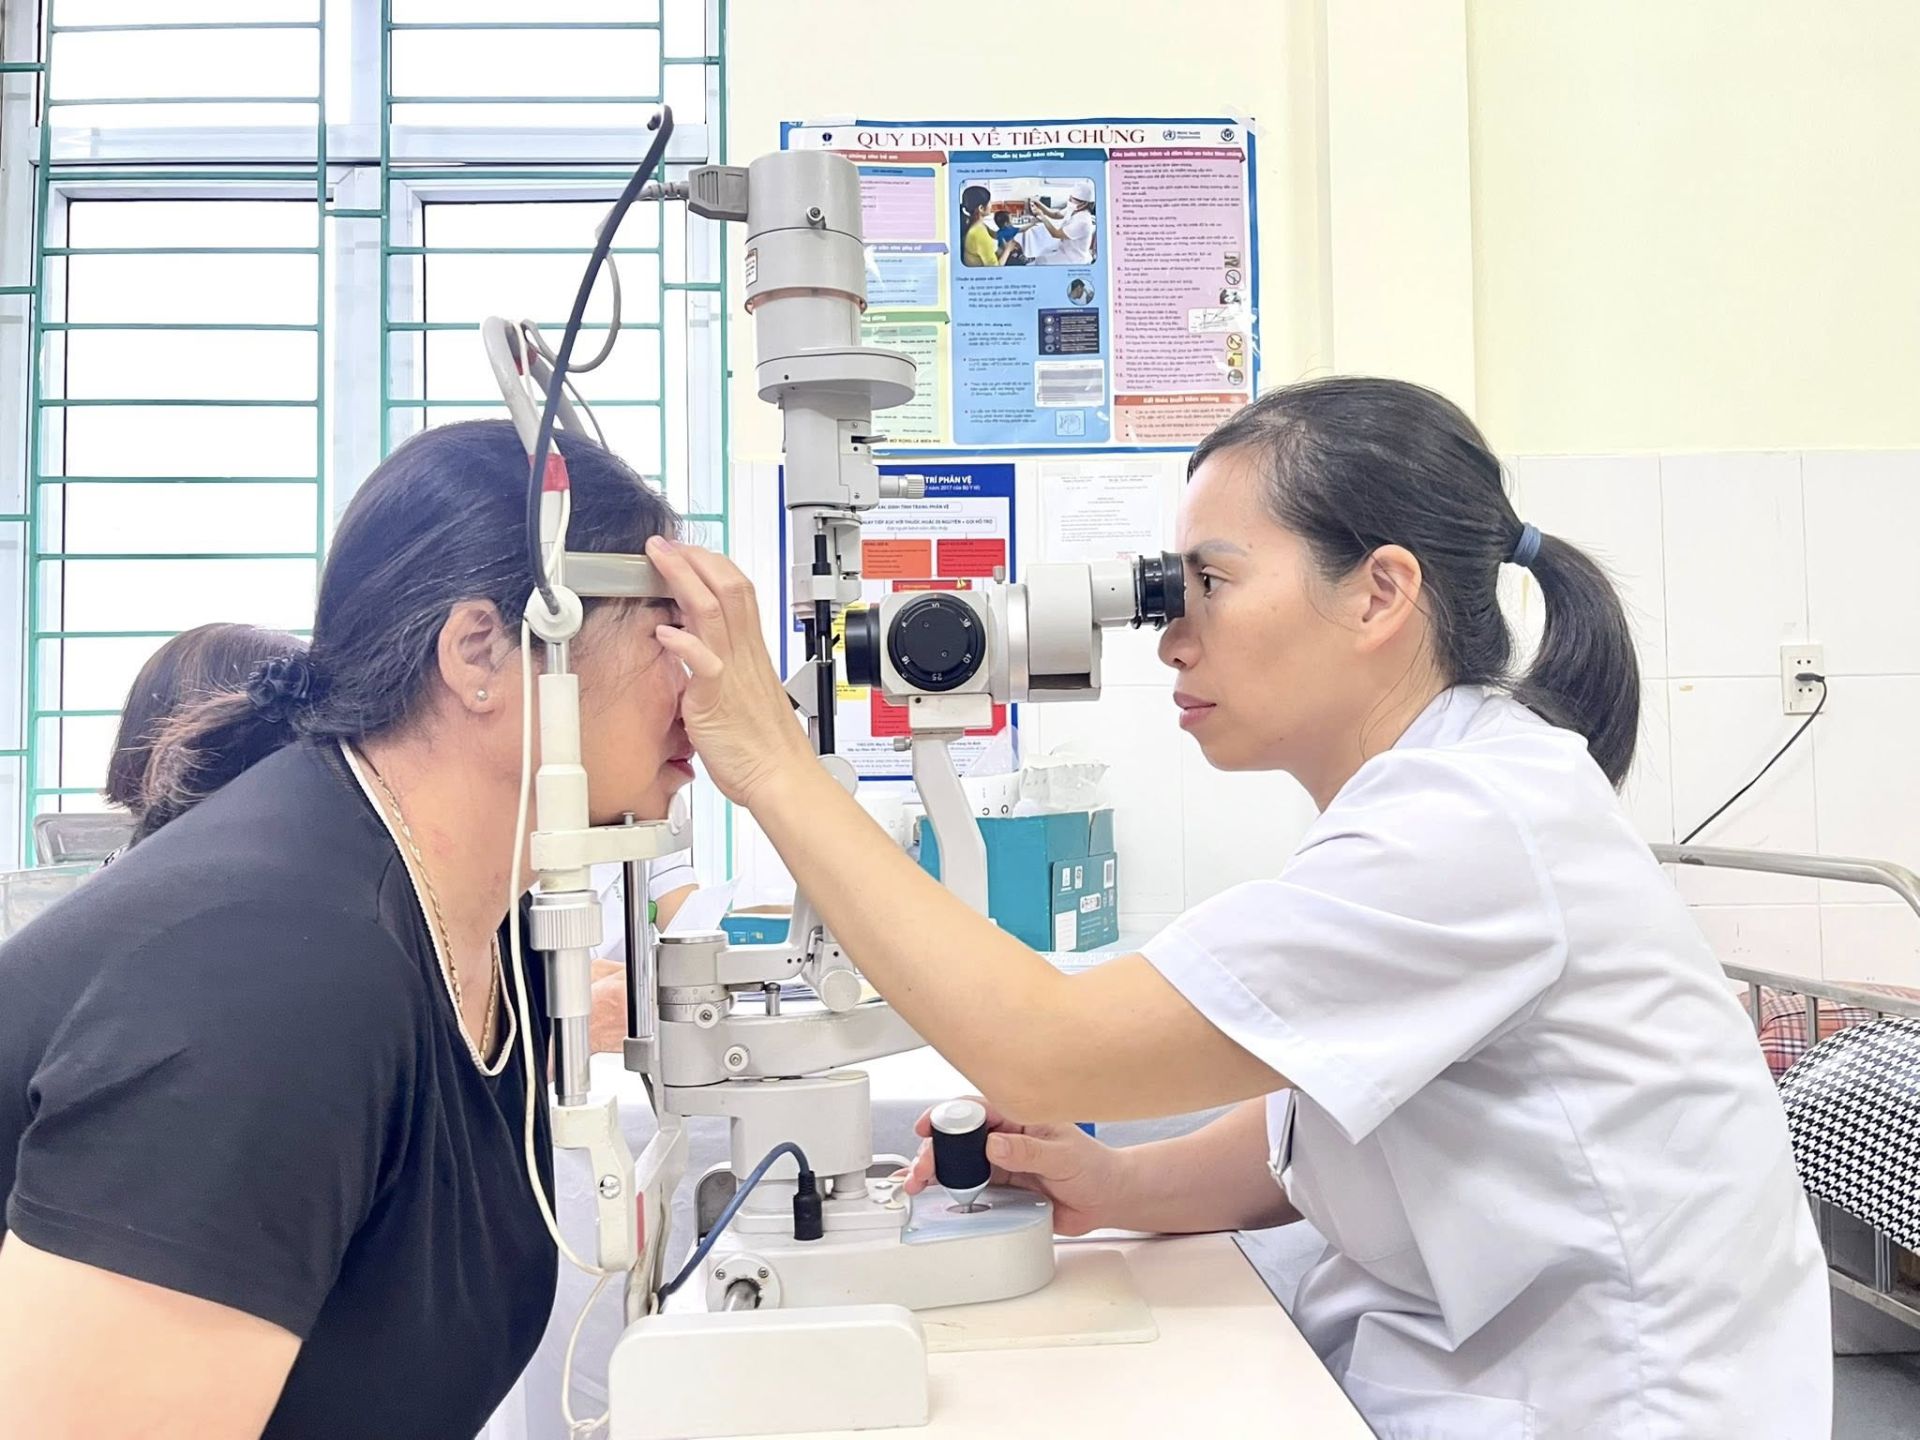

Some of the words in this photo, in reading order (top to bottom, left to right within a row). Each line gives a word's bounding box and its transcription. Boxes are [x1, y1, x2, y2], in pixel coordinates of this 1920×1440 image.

[857, 131, 903, 149] QUY
[911, 131, 963, 149] ĐỊNH
[971, 126, 1001, 146] VỀ
[1008, 127, 1060, 146] TIÊM
[1067, 125, 1145, 145] CHỦNG
[931, 672, 943, 681] 25
